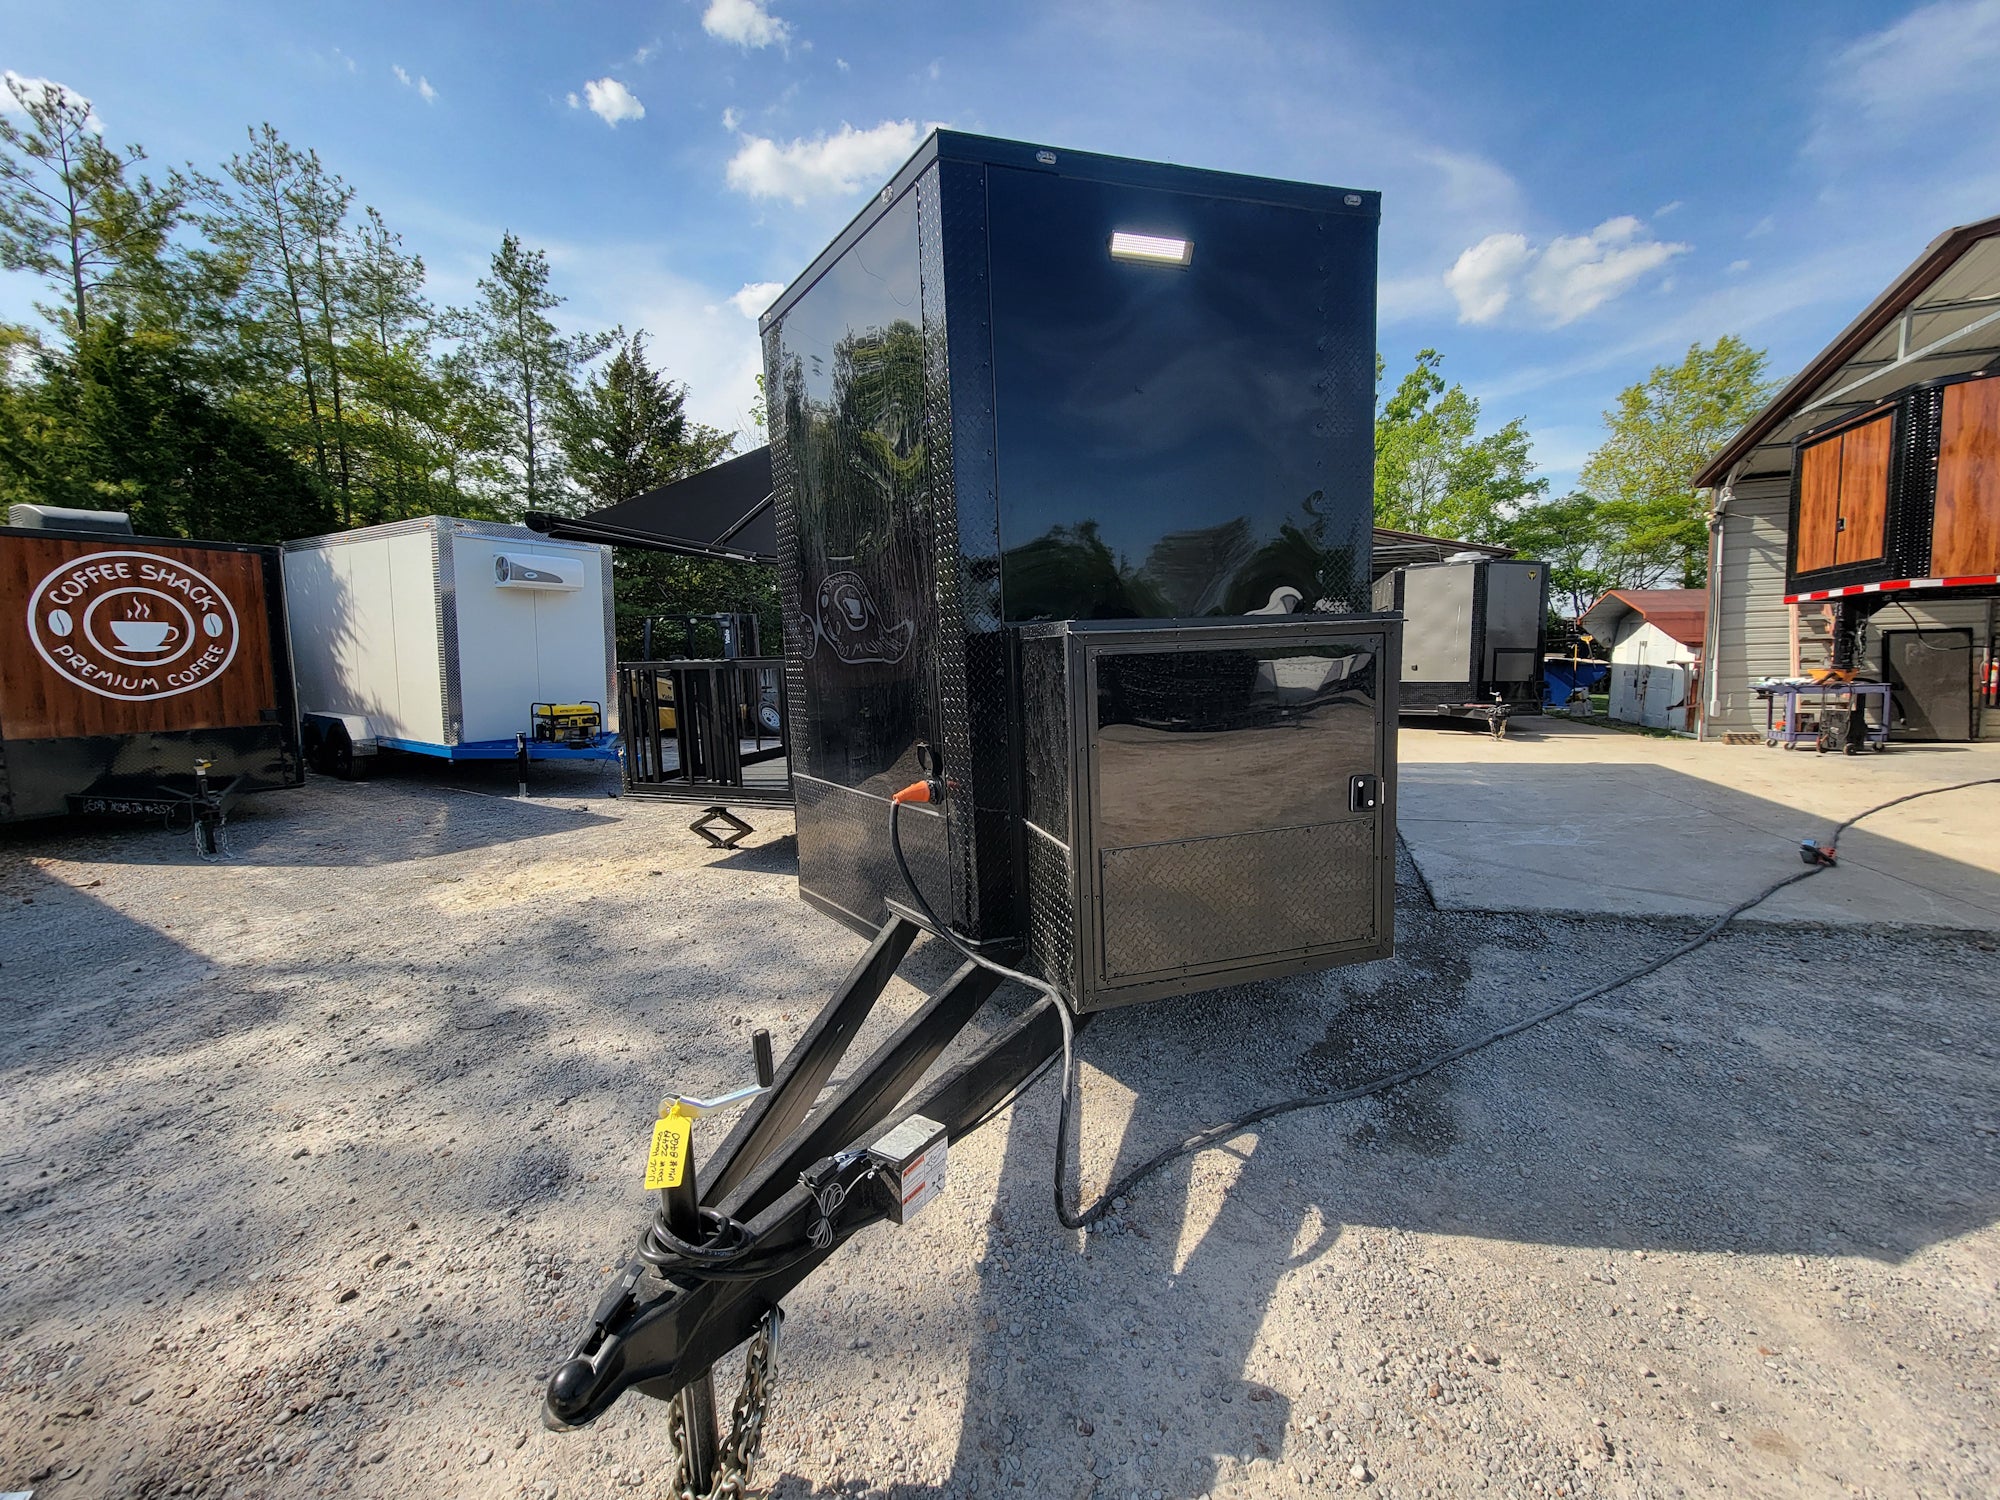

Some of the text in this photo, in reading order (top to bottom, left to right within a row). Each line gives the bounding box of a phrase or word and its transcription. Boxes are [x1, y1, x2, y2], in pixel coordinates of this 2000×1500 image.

[49, 562, 217, 611] COFFEE SHACK
[53, 644, 224, 690] PREMIUM COFFEE
